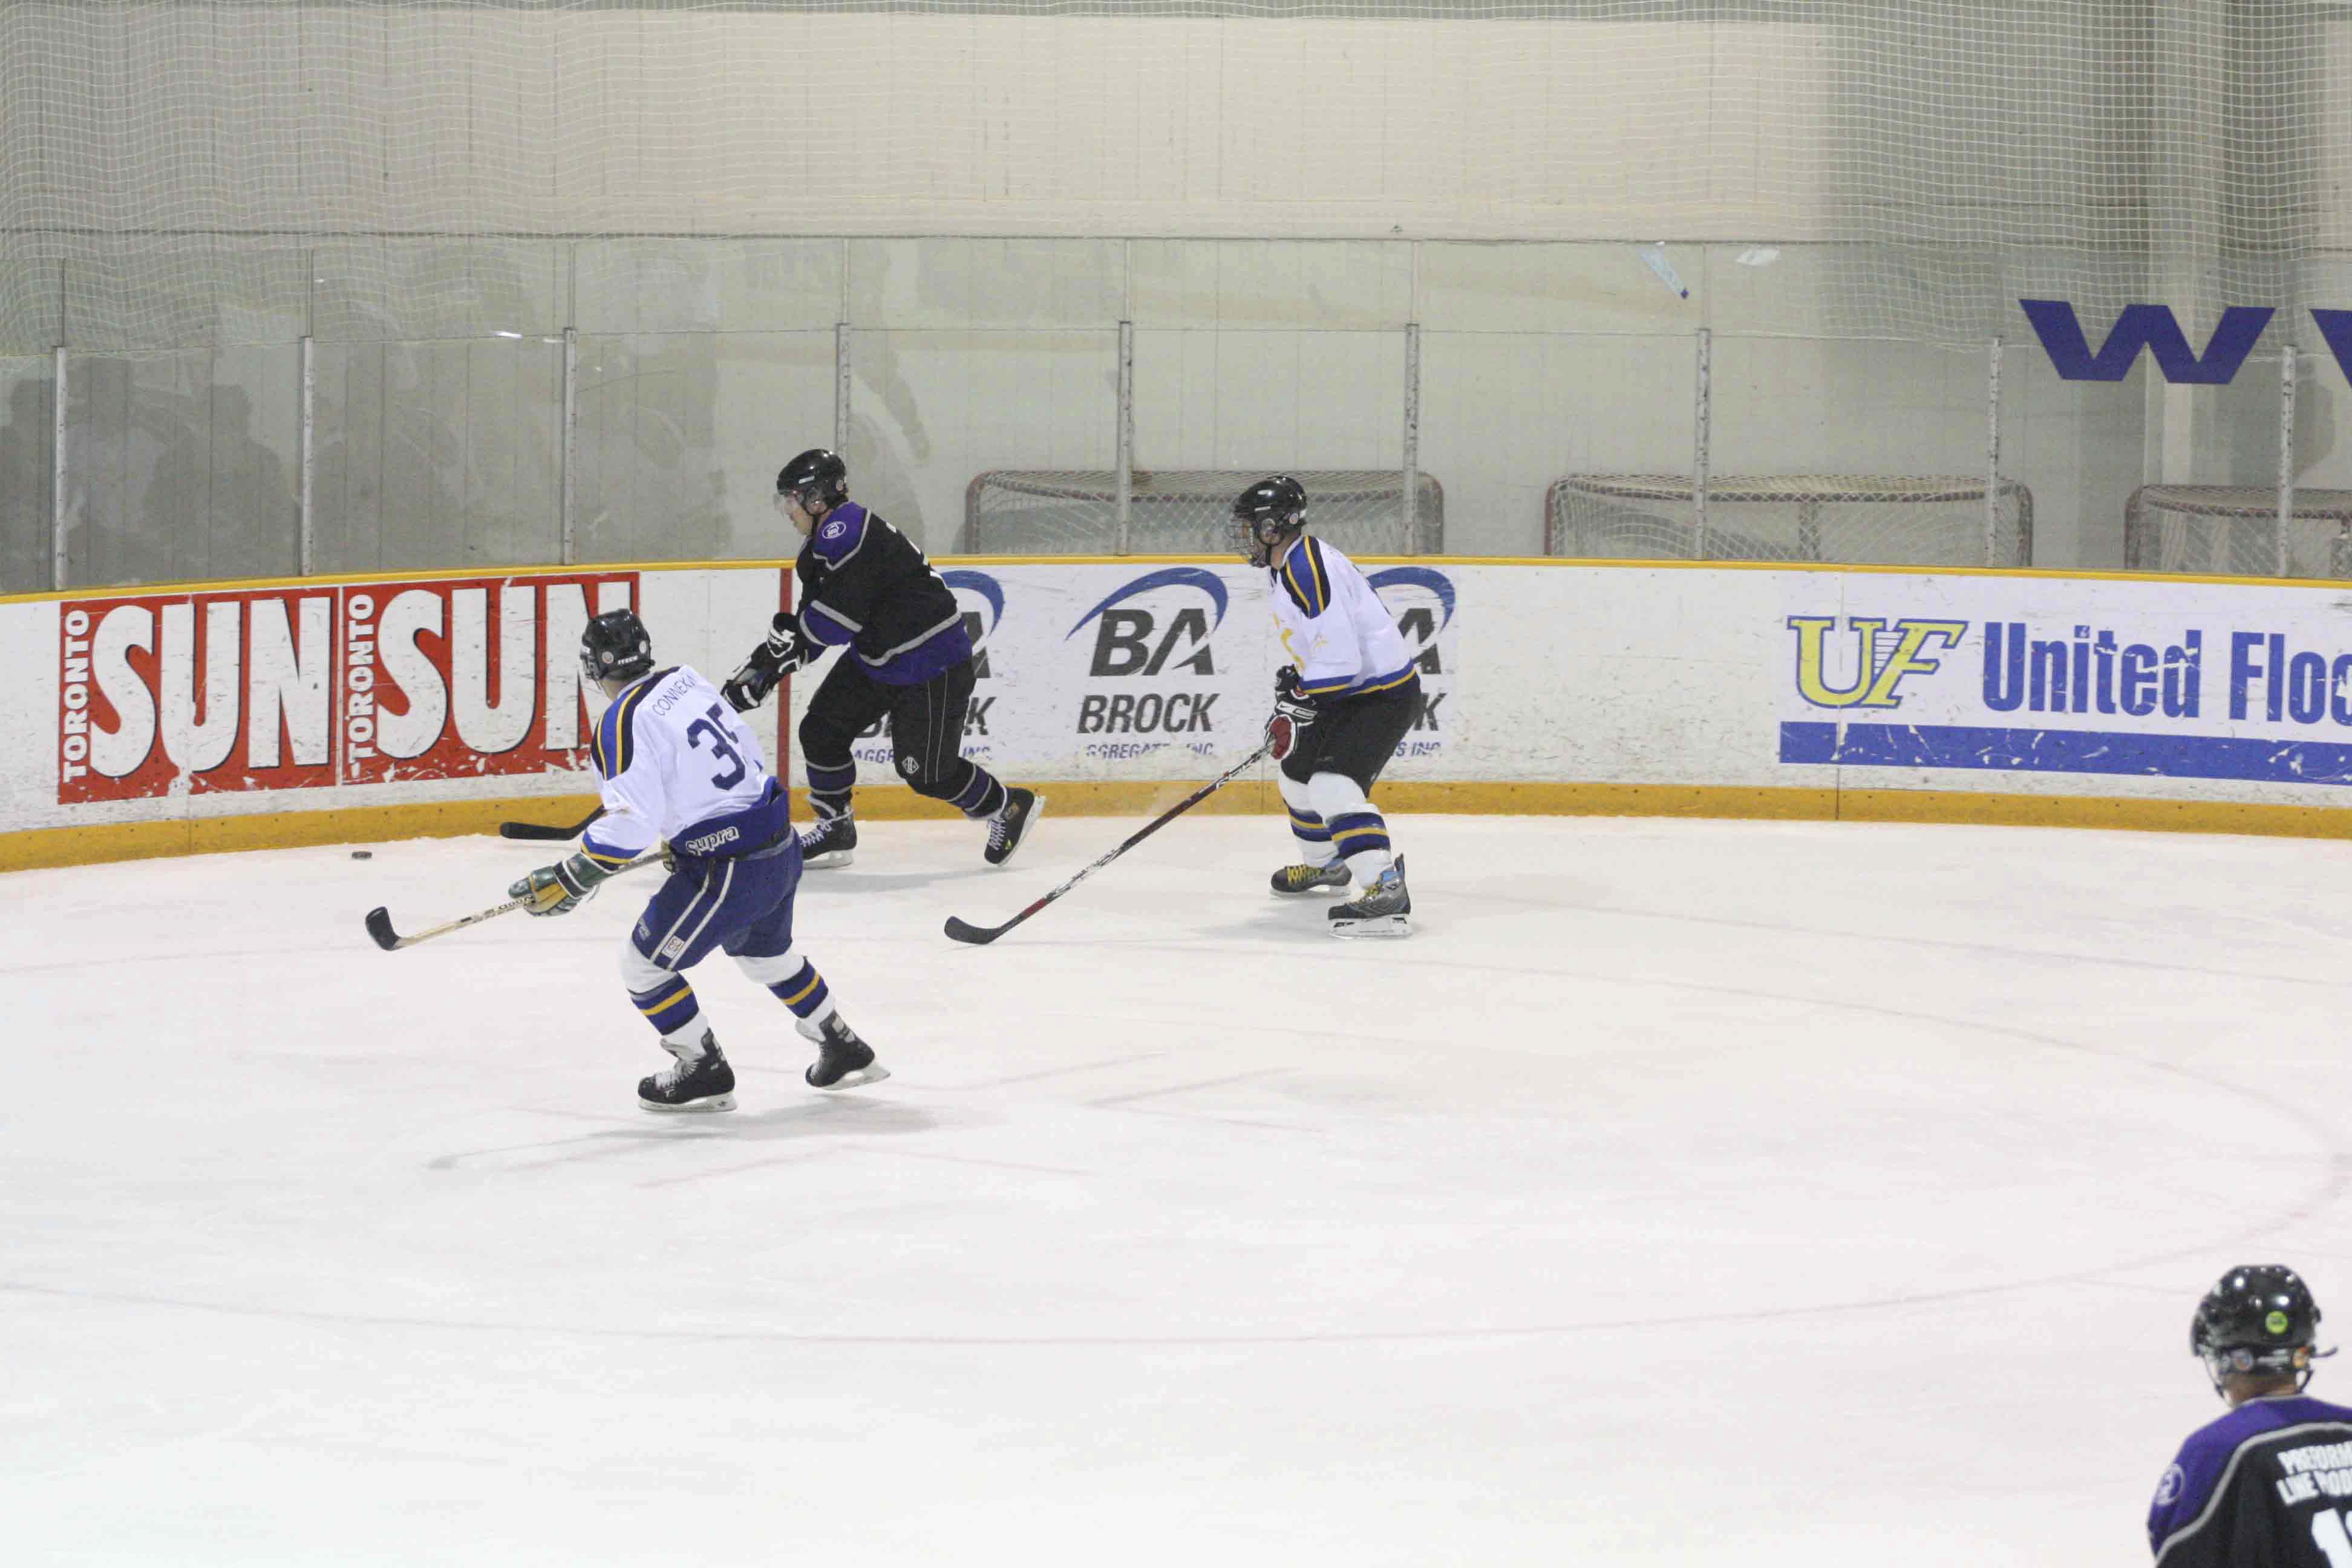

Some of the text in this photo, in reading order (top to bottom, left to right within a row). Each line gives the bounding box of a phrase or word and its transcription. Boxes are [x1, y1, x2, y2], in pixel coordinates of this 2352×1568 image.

[89, 596, 332, 778] SUN
[347, 593, 377, 766] TORONTO
[1088, 607, 1215, 676] BA
[1785, 615, 1969, 710] UF
[1981, 621, 2203, 719] United
[63, 609, 90, 783] TORONTO
[1076, 693, 1220, 734] BROCK
